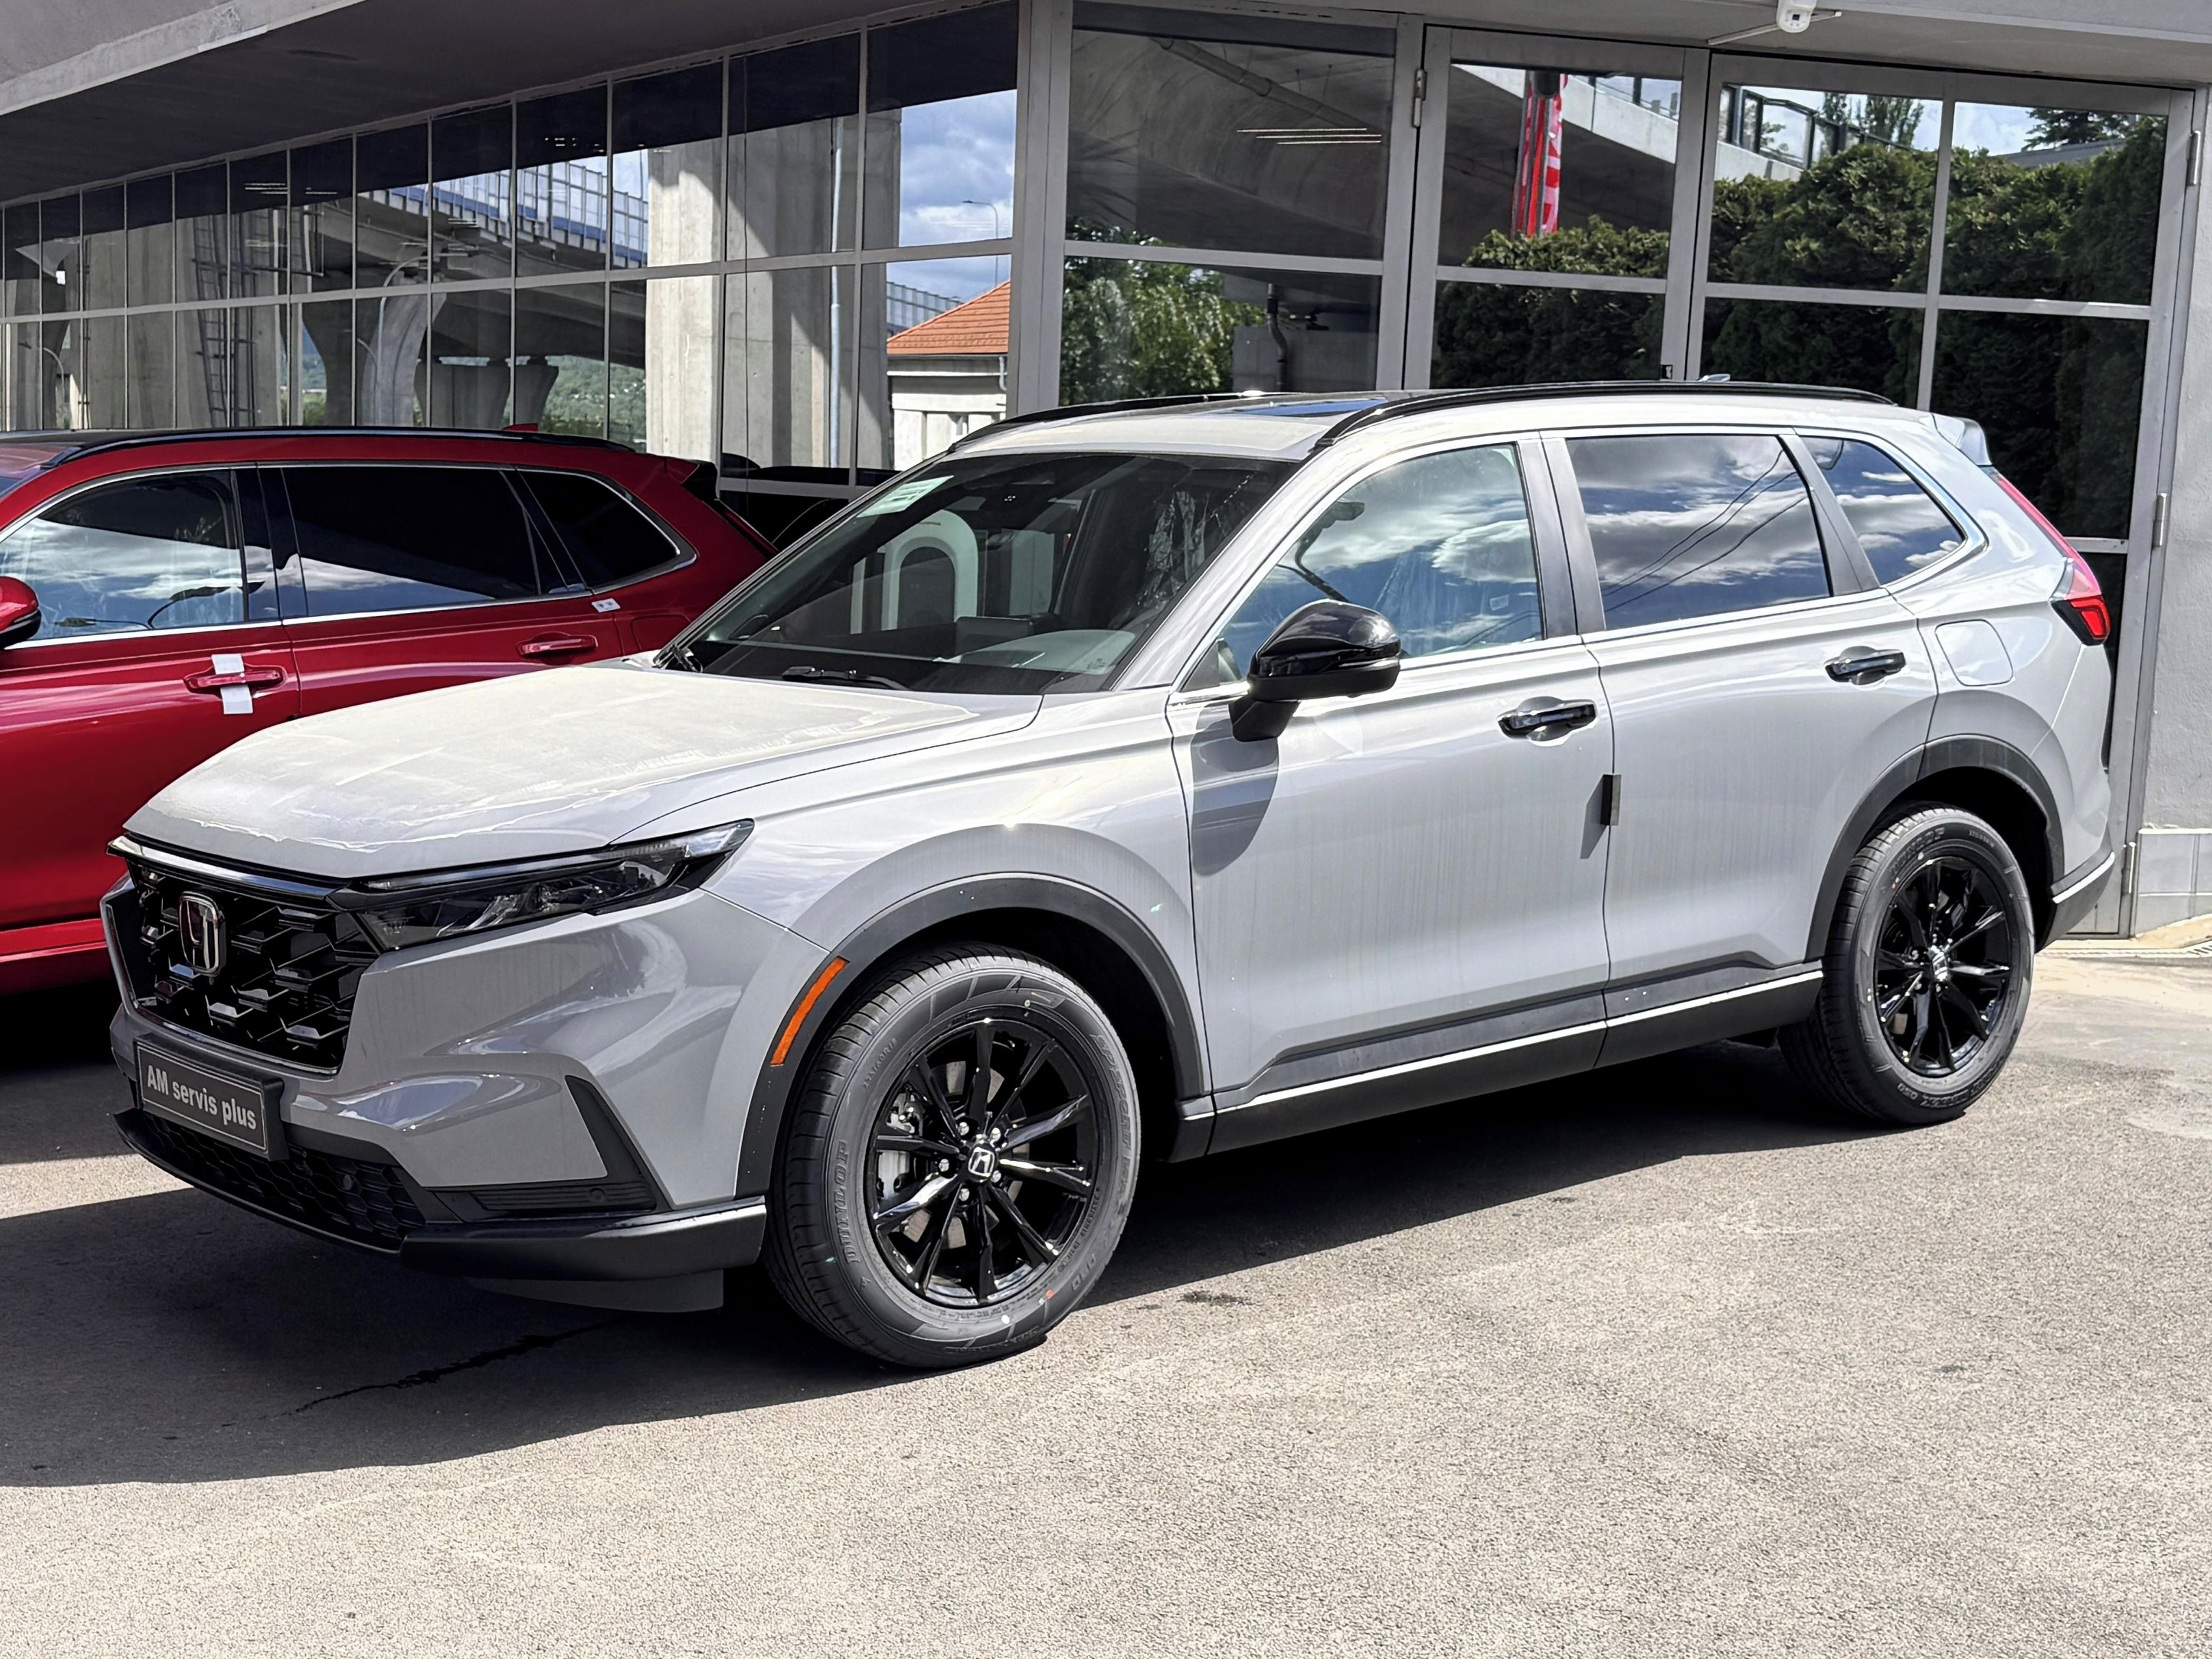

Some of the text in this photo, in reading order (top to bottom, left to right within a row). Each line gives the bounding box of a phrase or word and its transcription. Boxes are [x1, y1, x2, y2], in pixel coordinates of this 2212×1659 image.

[147, 1065, 257, 1130] AM servis plus
[834, 1140, 860, 1264] DUNLOP
